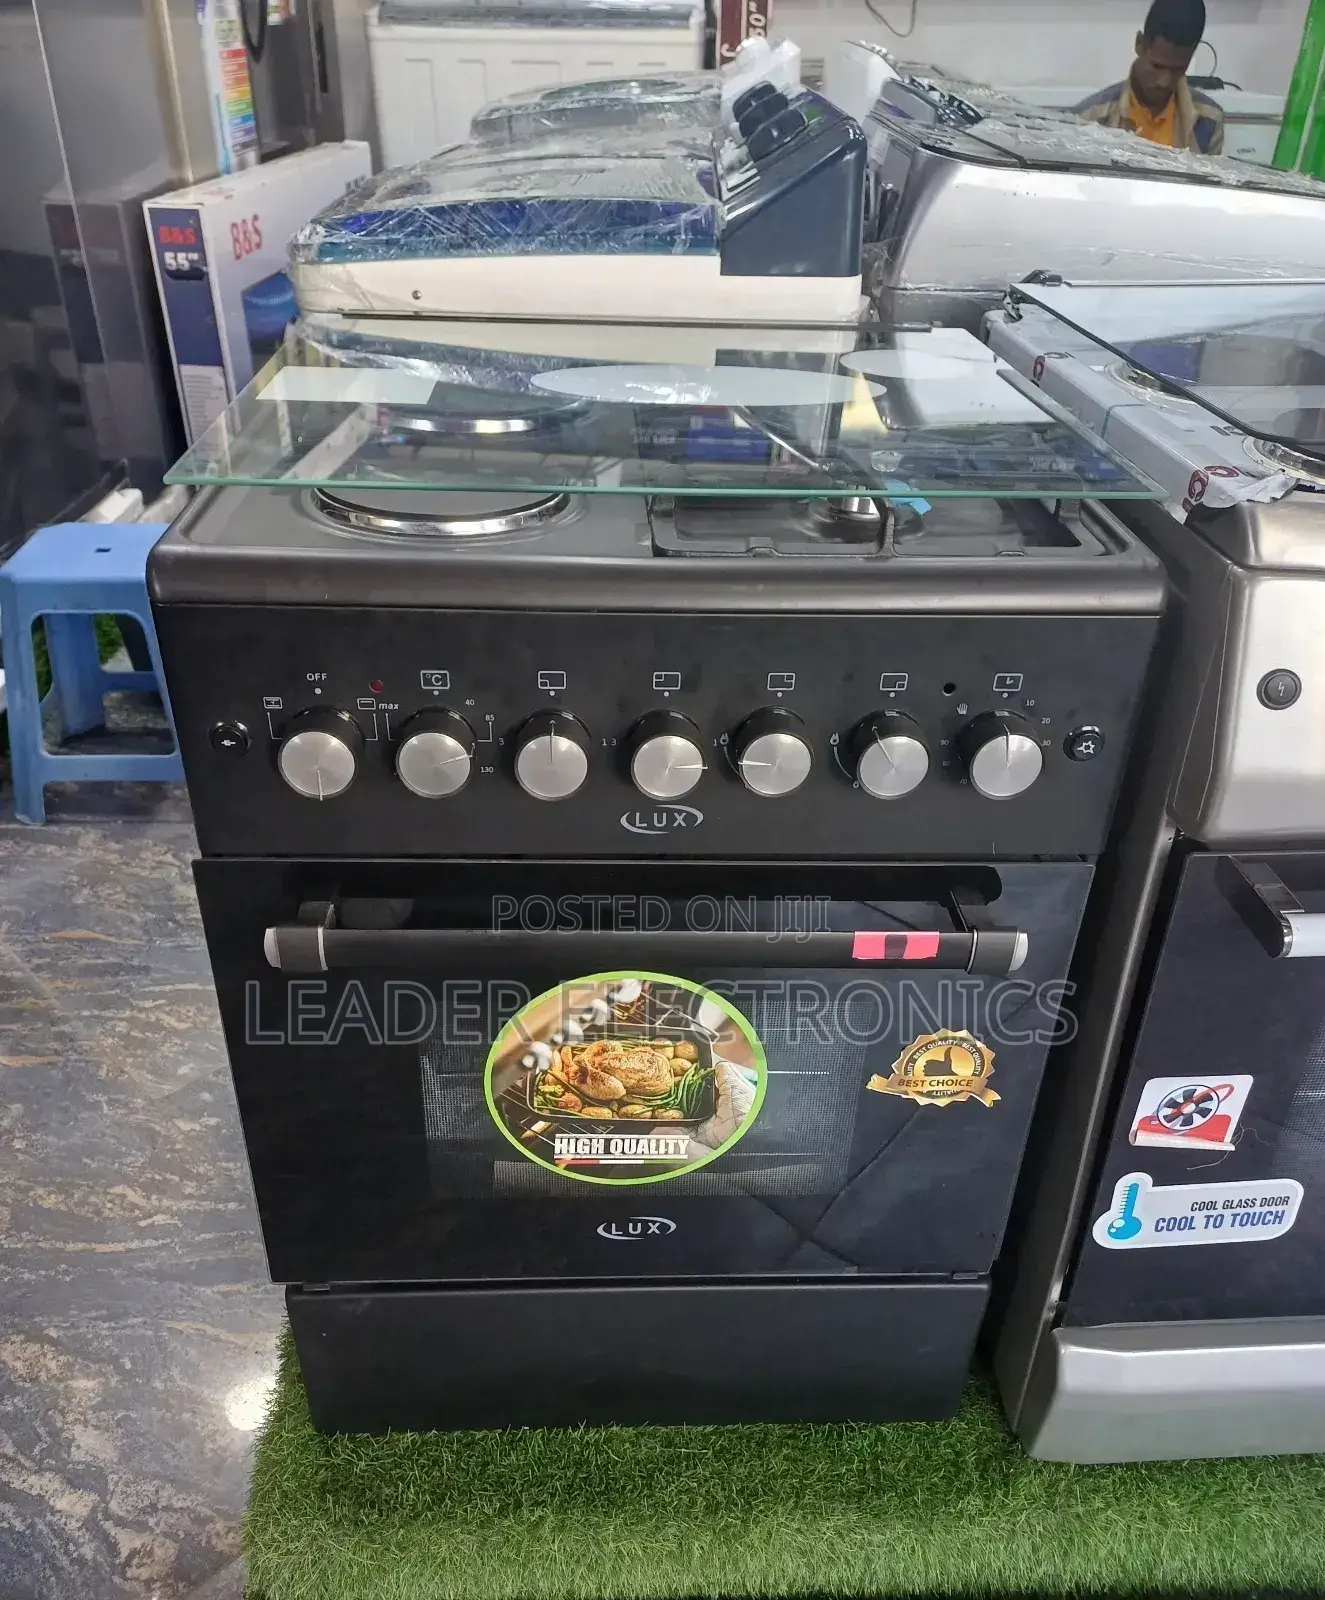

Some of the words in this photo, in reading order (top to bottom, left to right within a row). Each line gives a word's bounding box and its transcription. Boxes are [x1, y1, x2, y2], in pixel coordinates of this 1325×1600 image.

[306, 673, 327, 681] OFF
[378, 702, 399, 710] max
[635, 812, 687, 827] LUX
[913, 1046, 928, 1060] BEST
[927, 1039, 958, 1050] QUALITY
[961, 1042, 977, 1053] BEST
[897, 1078, 927, 1087] BEST
[929, 1079, 973, 1087] CHOICE
[554, 1138, 605, 1155] HIGH
[609, 1138, 690, 1155] QUALITY
[1190, 1200, 1218, 1212] COOL
[1222, 1198, 1257, 1210] GLASS
[1259, 1195, 1290, 1208] DOOR
[1154, 1215, 1197, 1232] COOL
[1203, 1213, 1225, 1229] TO
[1230, 1209, 1285, 1228] TOUCH
[611, 1222, 661, 1235] LUX
